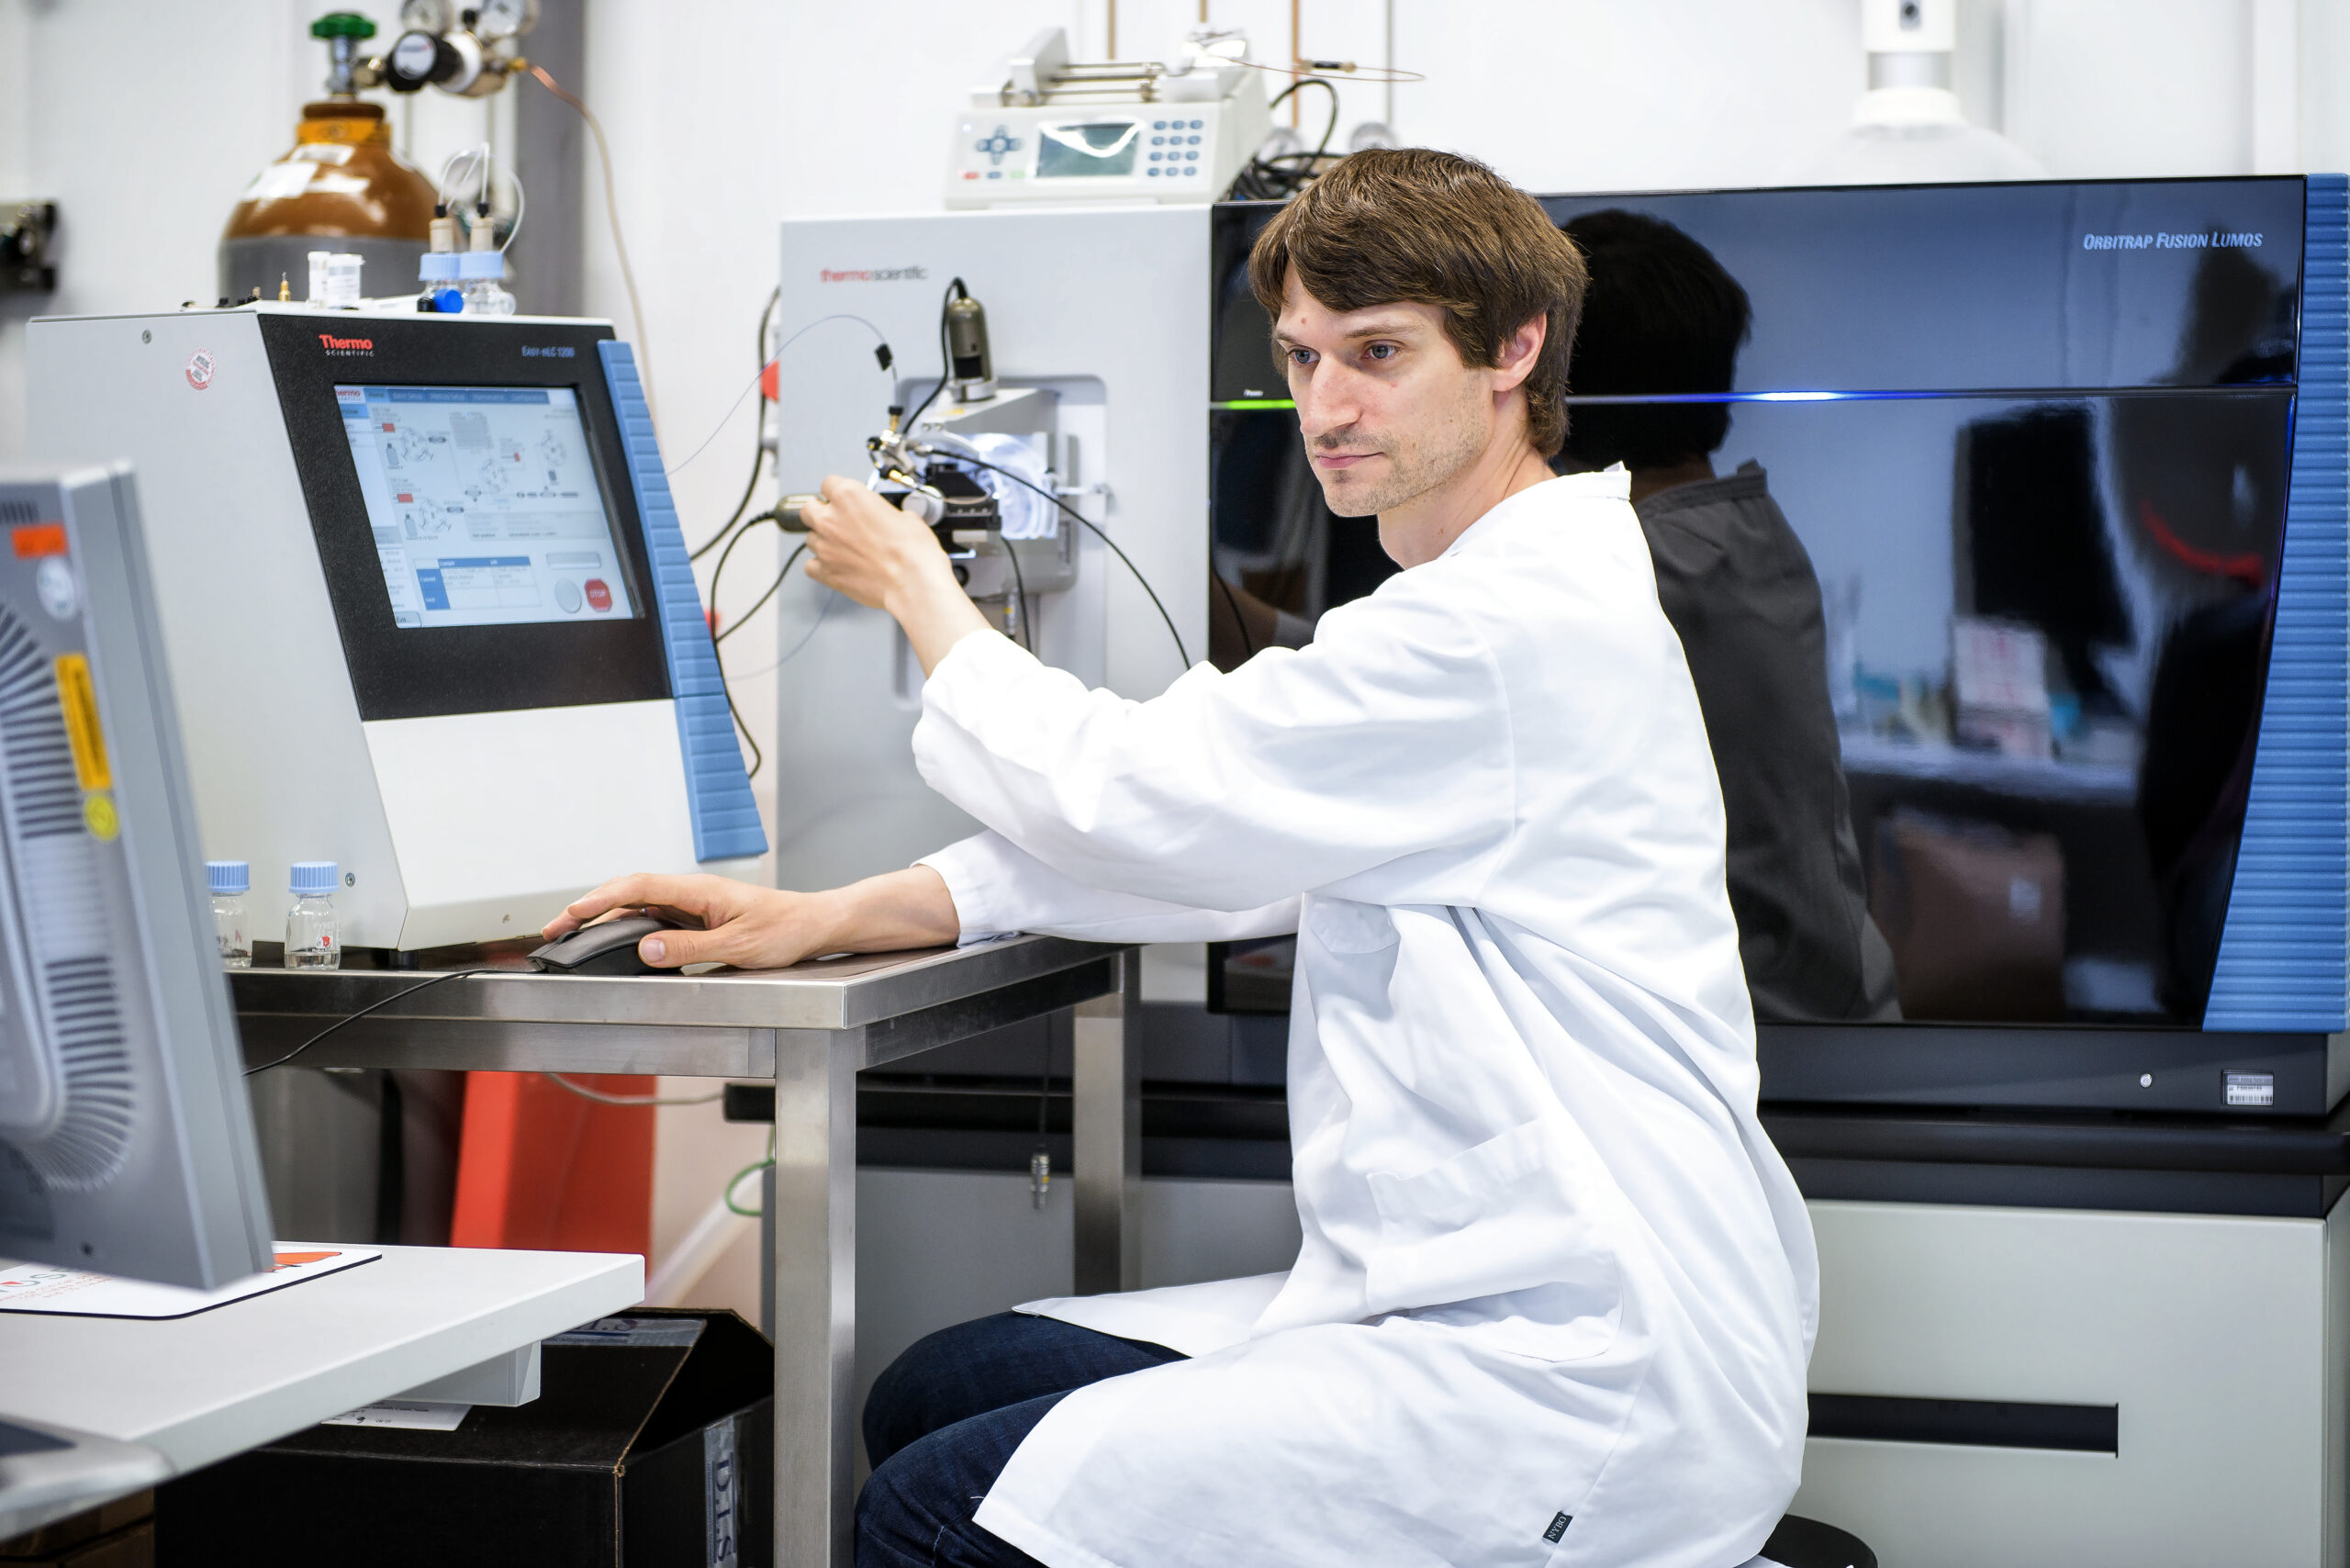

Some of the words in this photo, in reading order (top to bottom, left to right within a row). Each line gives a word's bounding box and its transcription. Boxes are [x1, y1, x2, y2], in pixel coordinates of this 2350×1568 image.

[2083, 233, 2154, 250] ORBITRAP
[2155, 231, 2209, 249] FUSION
[2210, 231, 2264, 248] LUMOS
[319, 333, 374, 351] Thermo
[325, 349, 375, 358] SCIENTIFIC
[1547, 1516, 1567, 1540] NYBO
